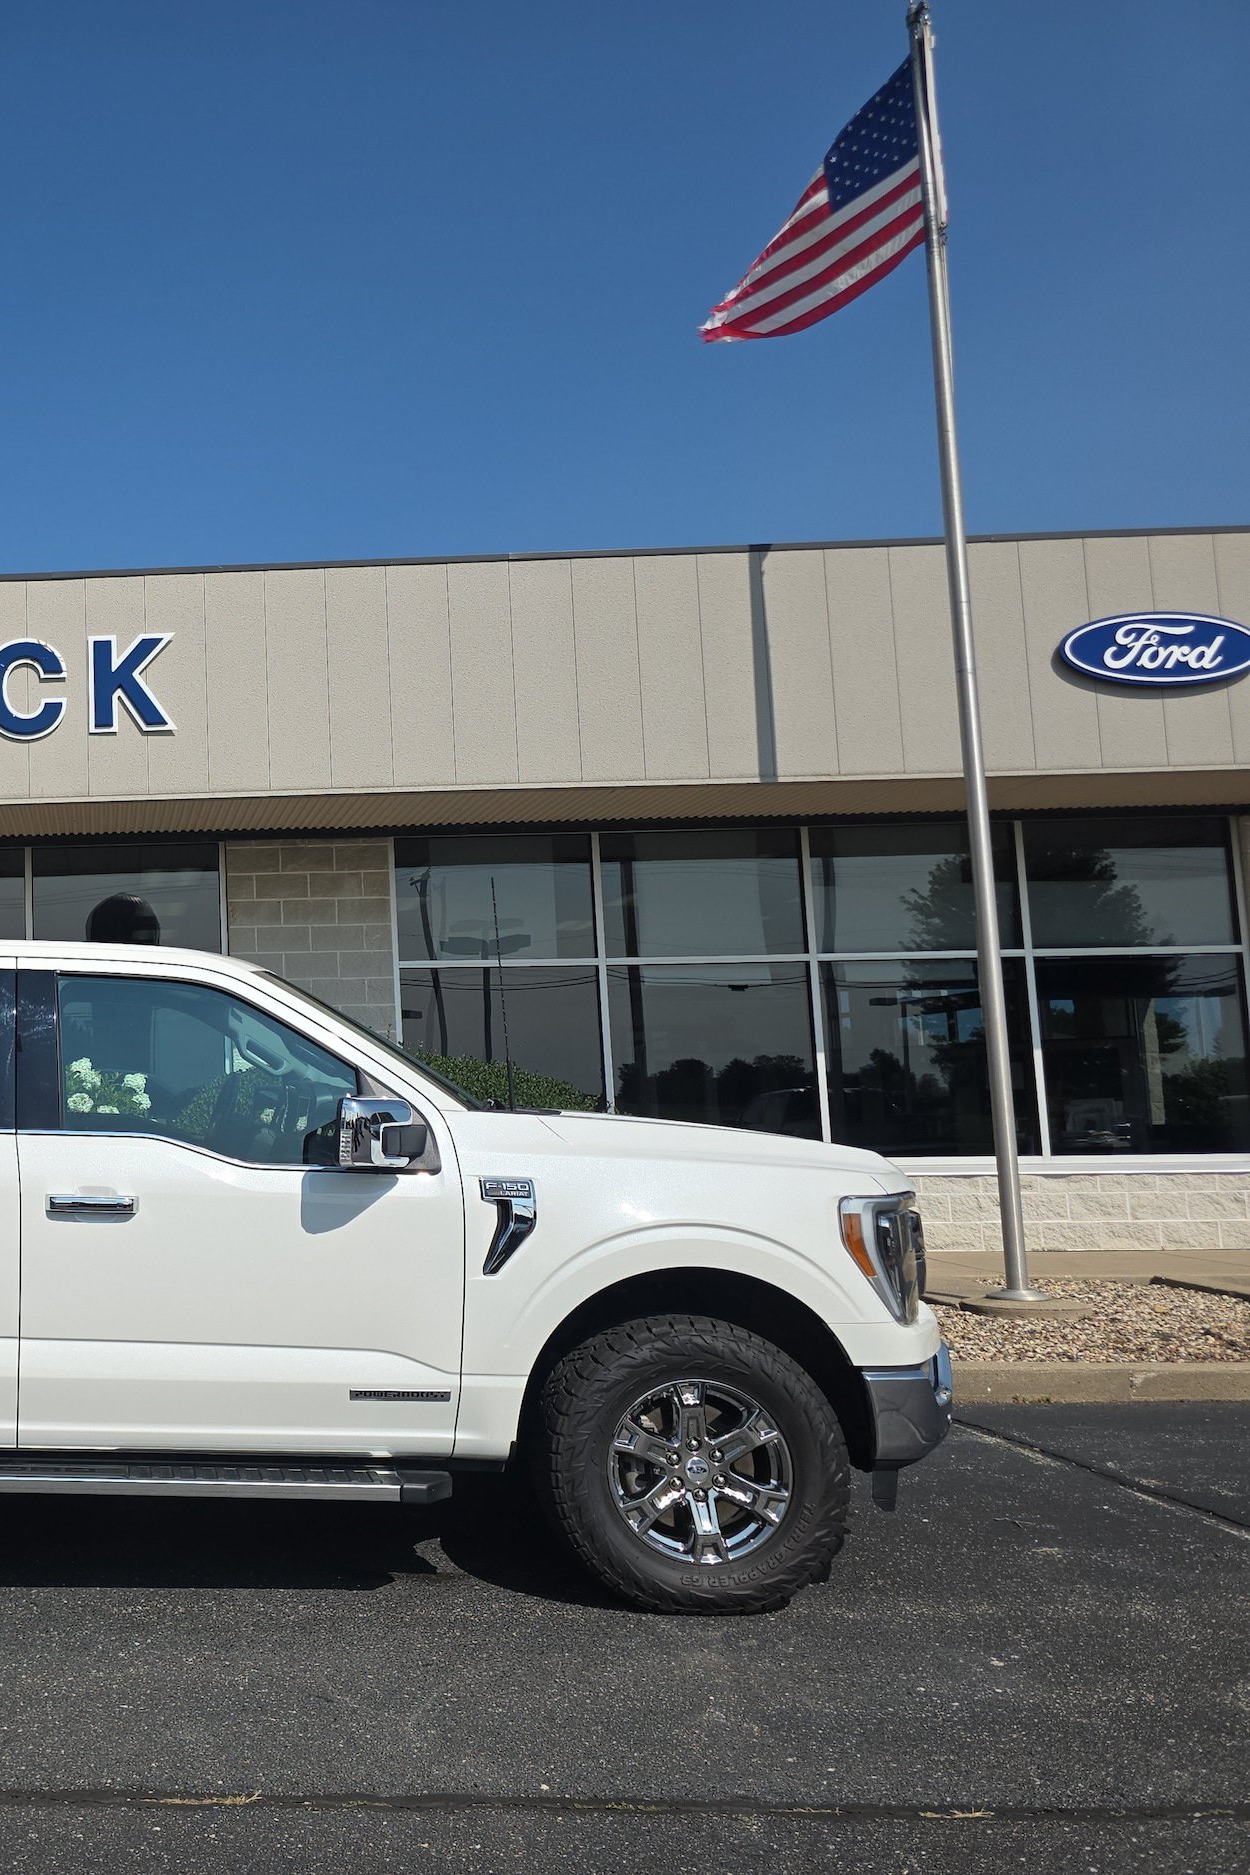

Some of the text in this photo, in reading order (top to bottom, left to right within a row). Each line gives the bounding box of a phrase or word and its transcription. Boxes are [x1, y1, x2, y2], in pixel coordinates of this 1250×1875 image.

[1103, 623, 1226, 670] Ford
[485, 1181, 530, 1191] F-150
[680, 1574, 703, 1587] G3
[707, 1550, 785, 1588] GRAPPLER
